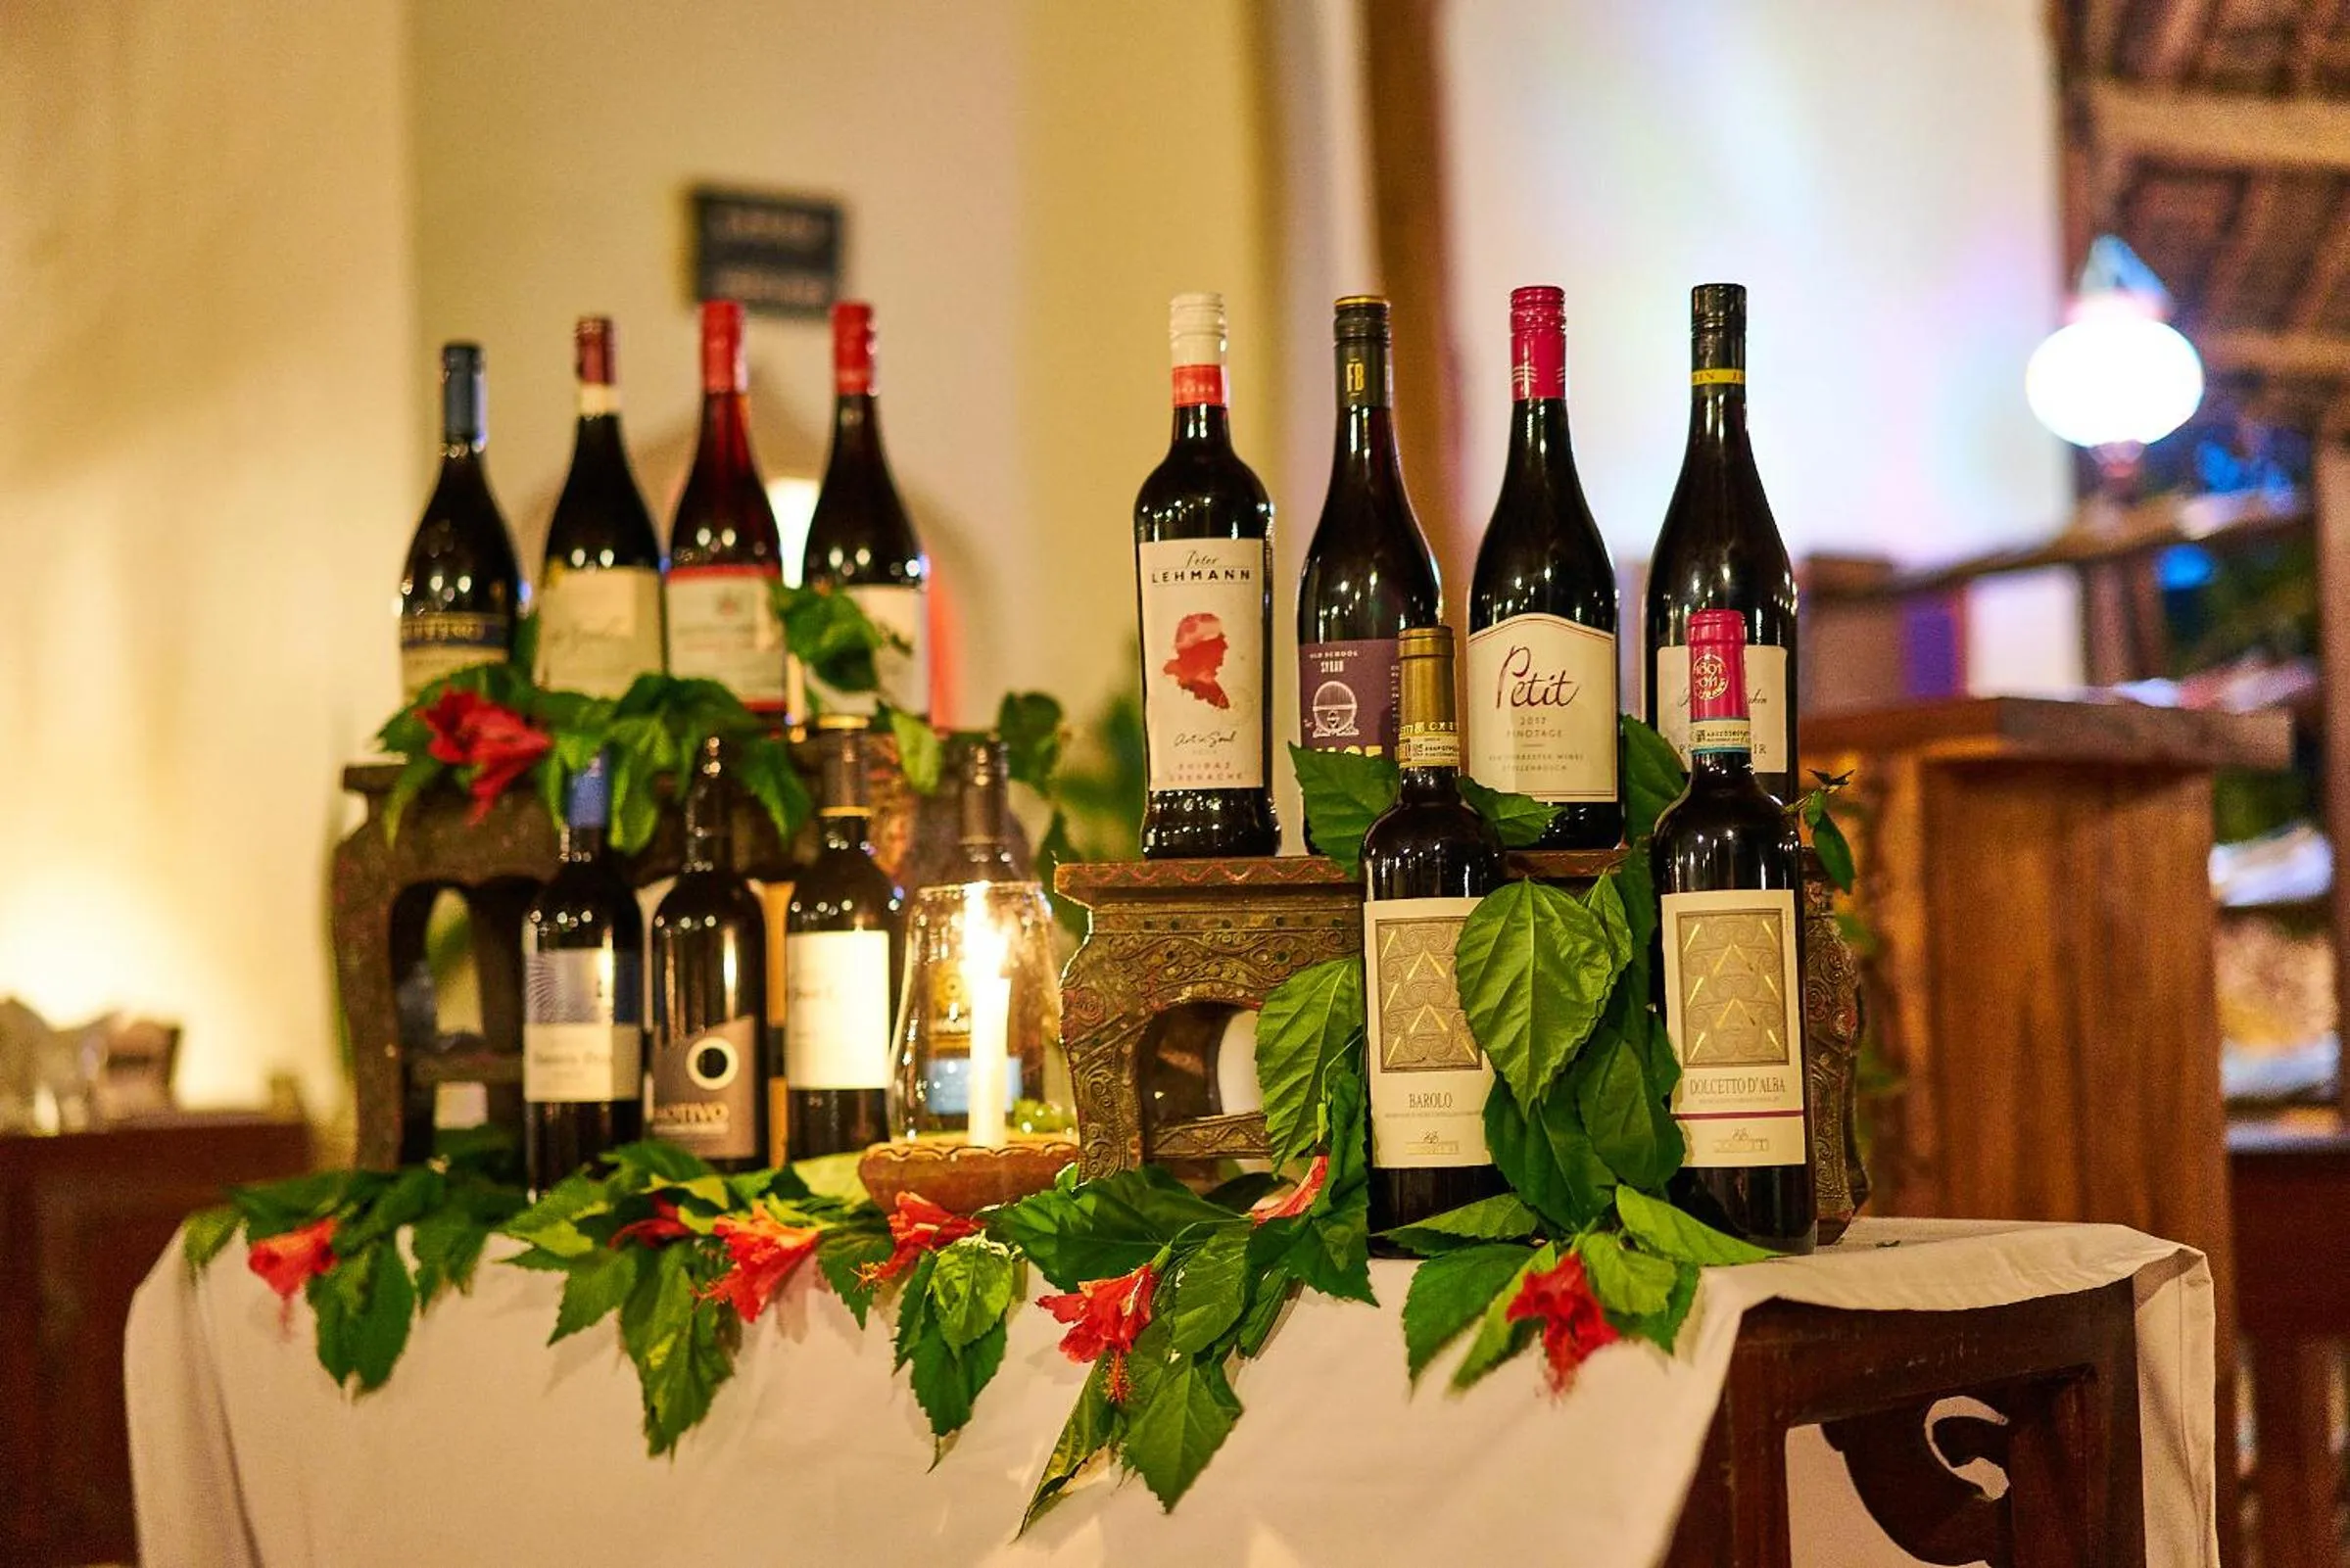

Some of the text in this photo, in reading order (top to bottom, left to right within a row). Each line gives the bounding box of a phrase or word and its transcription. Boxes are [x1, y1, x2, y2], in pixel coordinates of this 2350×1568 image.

[1151, 569, 1251, 584] LEHMANN
[1497, 644, 1580, 710] Petit
[1506, 728, 1562, 738] PINOTAGE
[1689, 1076, 1787, 1095] DOLCETTO D'ALBA
[1409, 1092, 1453, 1109] BAROLO
